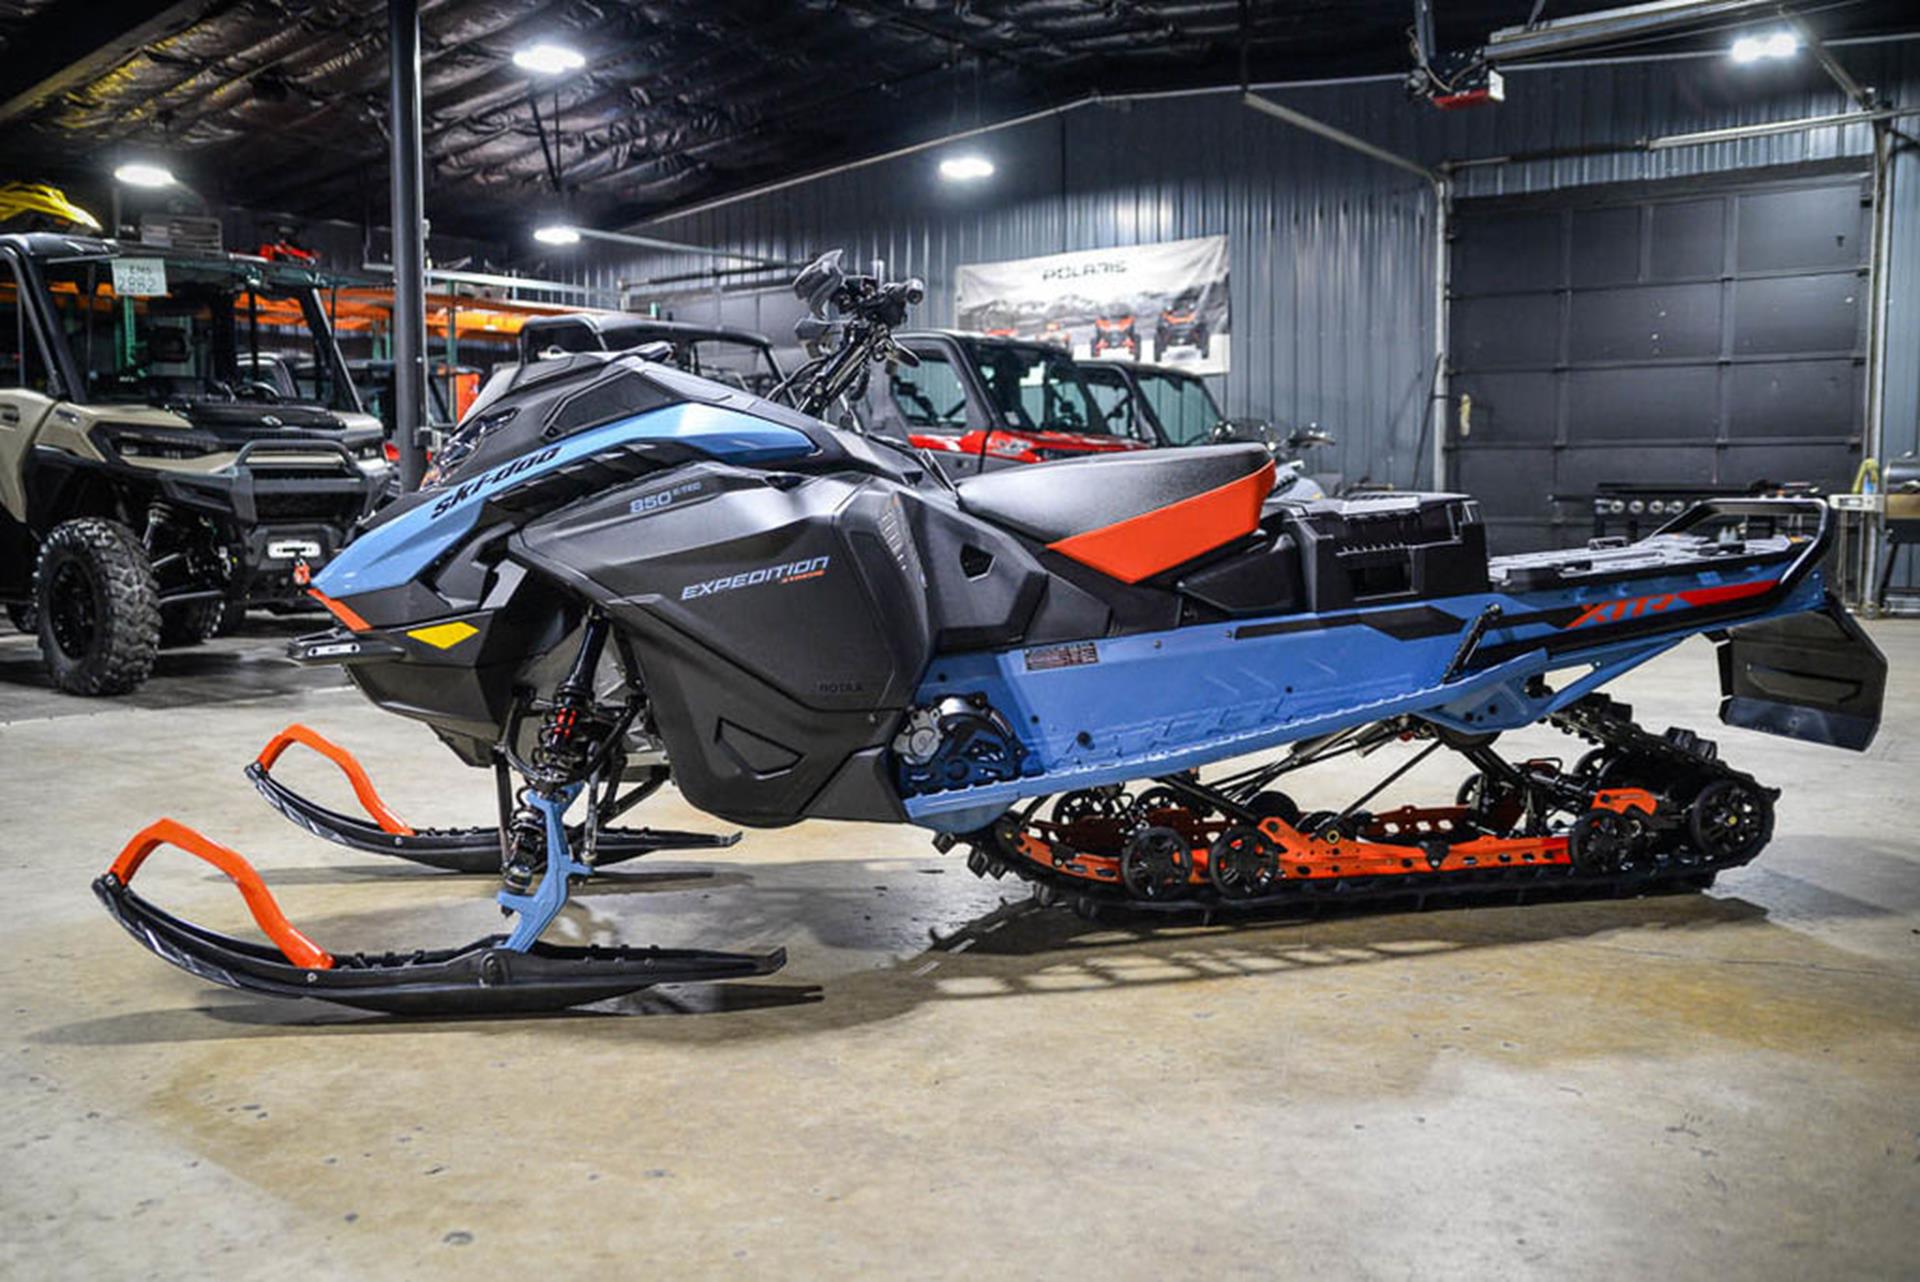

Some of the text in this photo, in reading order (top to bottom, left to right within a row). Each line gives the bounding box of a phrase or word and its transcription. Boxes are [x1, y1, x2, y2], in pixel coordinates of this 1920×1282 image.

[1042, 261, 1127, 281] POLARIS
[630, 491, 672, 513] 850
[681, 556, 830, 600] EXPEDITION
